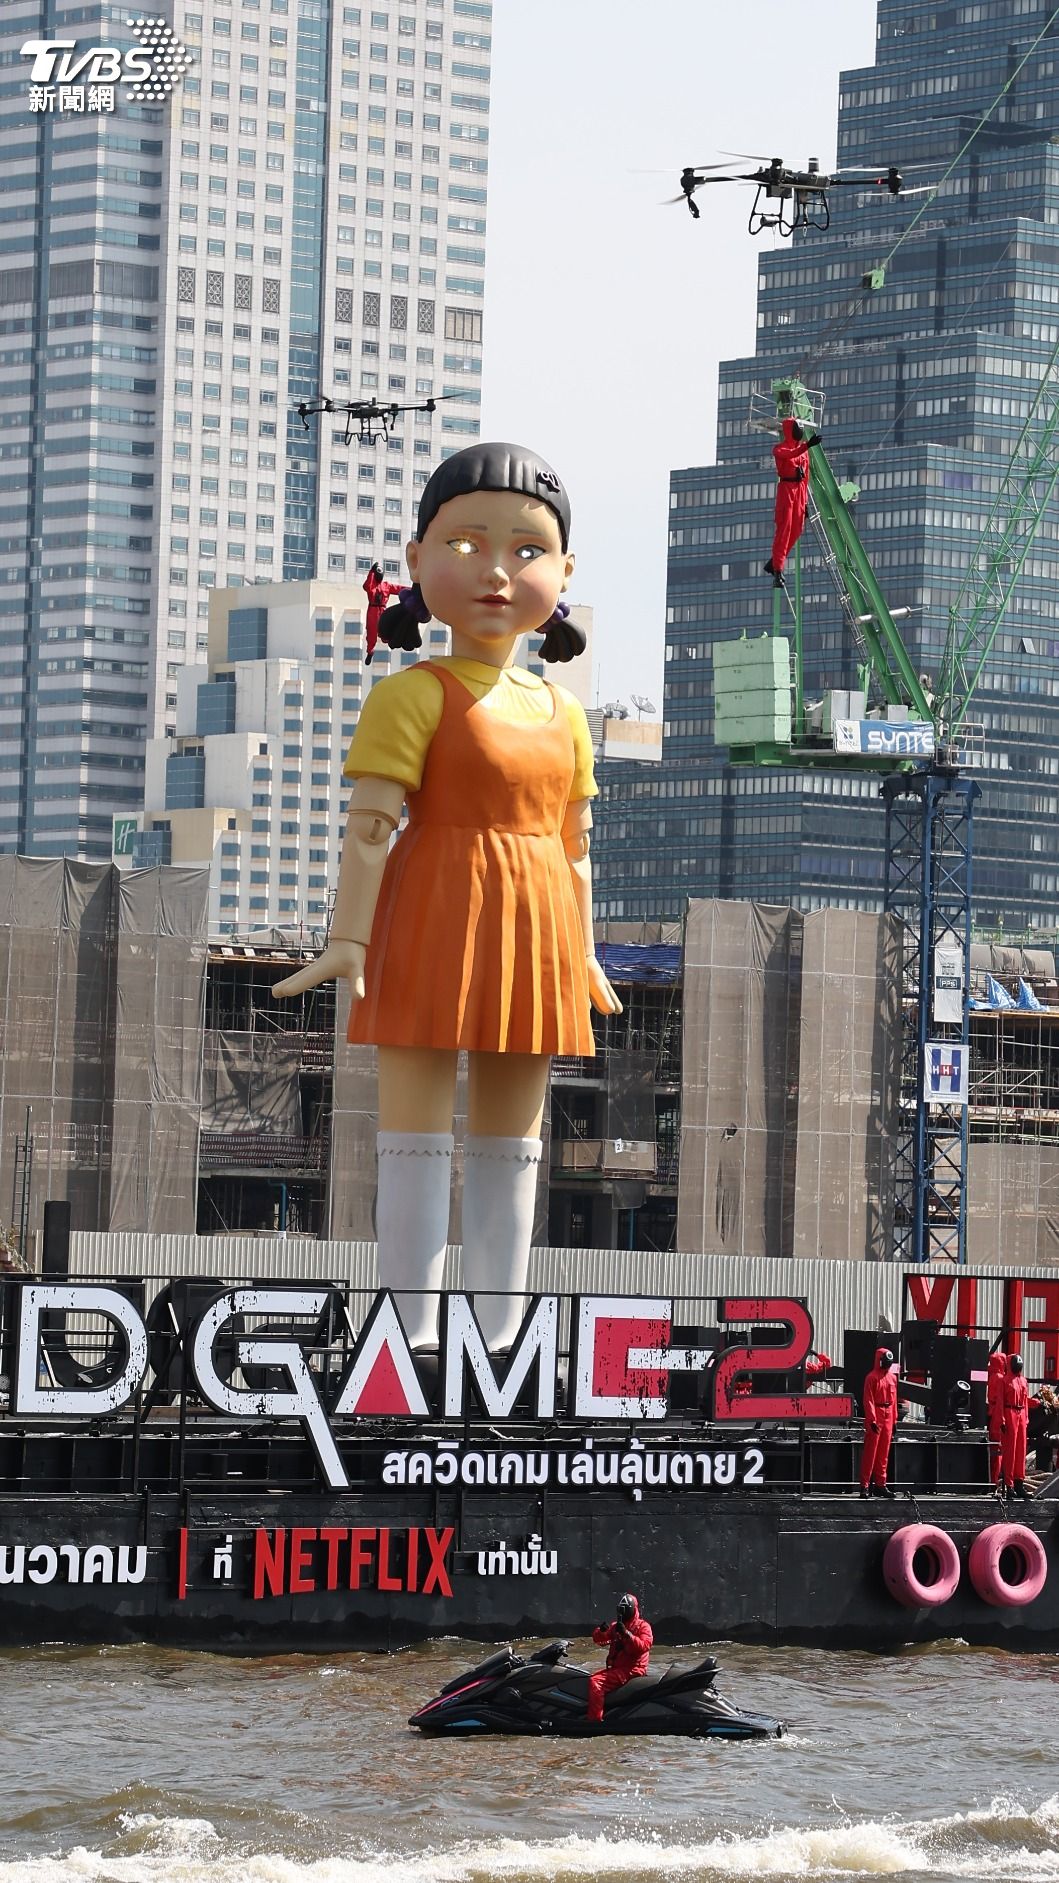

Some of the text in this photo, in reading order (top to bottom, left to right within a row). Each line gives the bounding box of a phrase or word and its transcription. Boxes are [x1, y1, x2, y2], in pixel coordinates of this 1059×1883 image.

[932, 1065, 960, 1076] HHT
[193, 1289, 714, 1488] GAME
[713, 1299, 853, 1420] 2
[382, 1438, 764, 1501] สควิดเกม เล่นลุ้นตาย 2
[213, 1535, 233, 1579] ที่
[253, 1527, 455, 1600] NETFLIX
[477, 1533, 558, 1576] เท่านั้น
